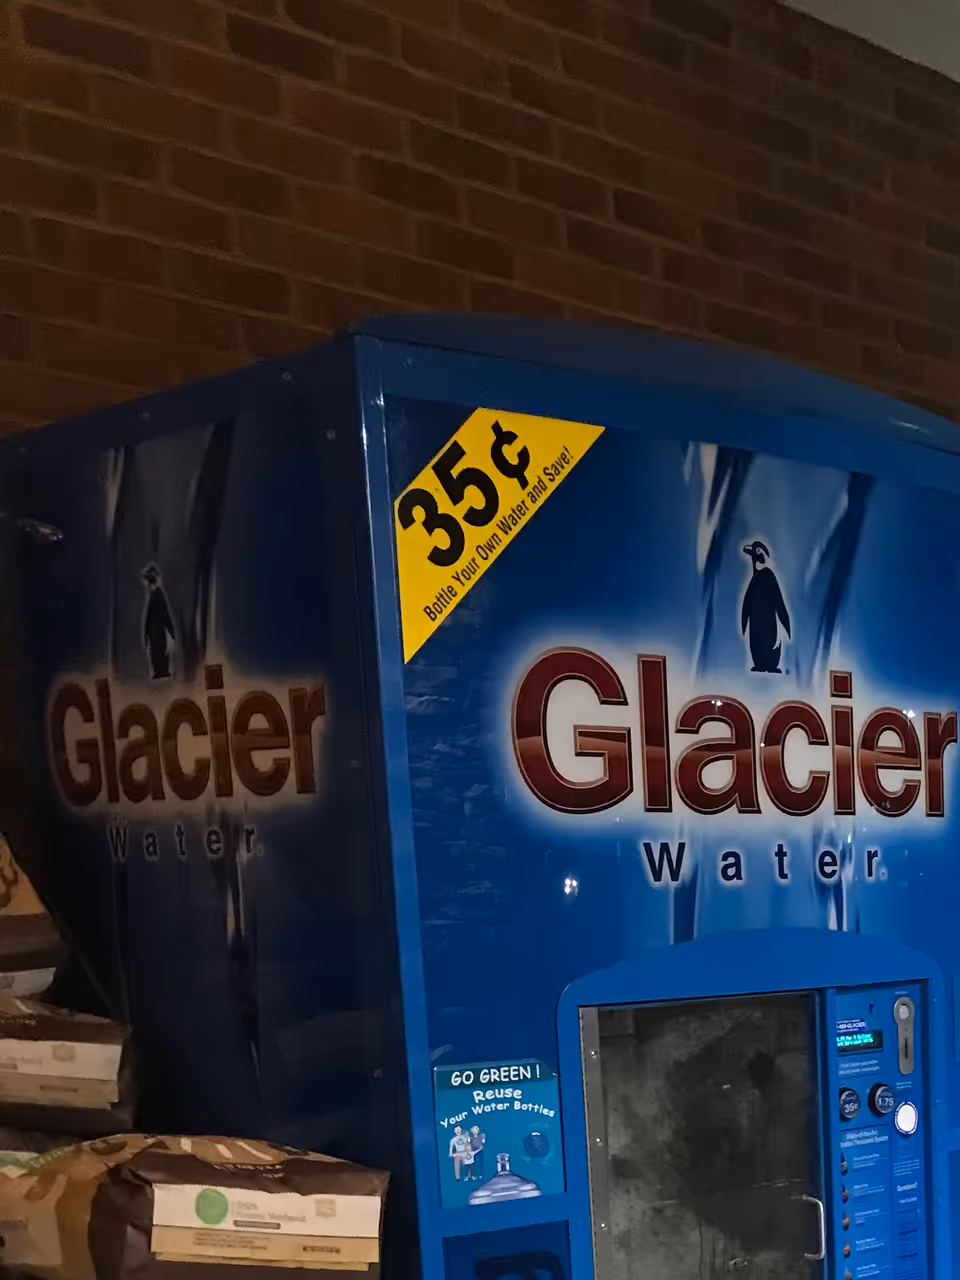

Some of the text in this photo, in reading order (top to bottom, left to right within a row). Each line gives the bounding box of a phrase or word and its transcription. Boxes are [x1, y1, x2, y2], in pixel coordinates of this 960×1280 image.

[398, 420, 530, 567] 35¢
[423, 445, 574, 622] Bottle Your Own Water and Save!
[50, 664, 326, 808] Glacier
[511, 646, 958, 818] Glacier
[642, 842, 880, 882] Water
[440, 1101, 556, 1128] Your Water Bottles
[451, 1071, 474, 1086] GO
[479, 1065, 531, 1084] GREEN
[472, 1087, 522, 1103] Reuse
